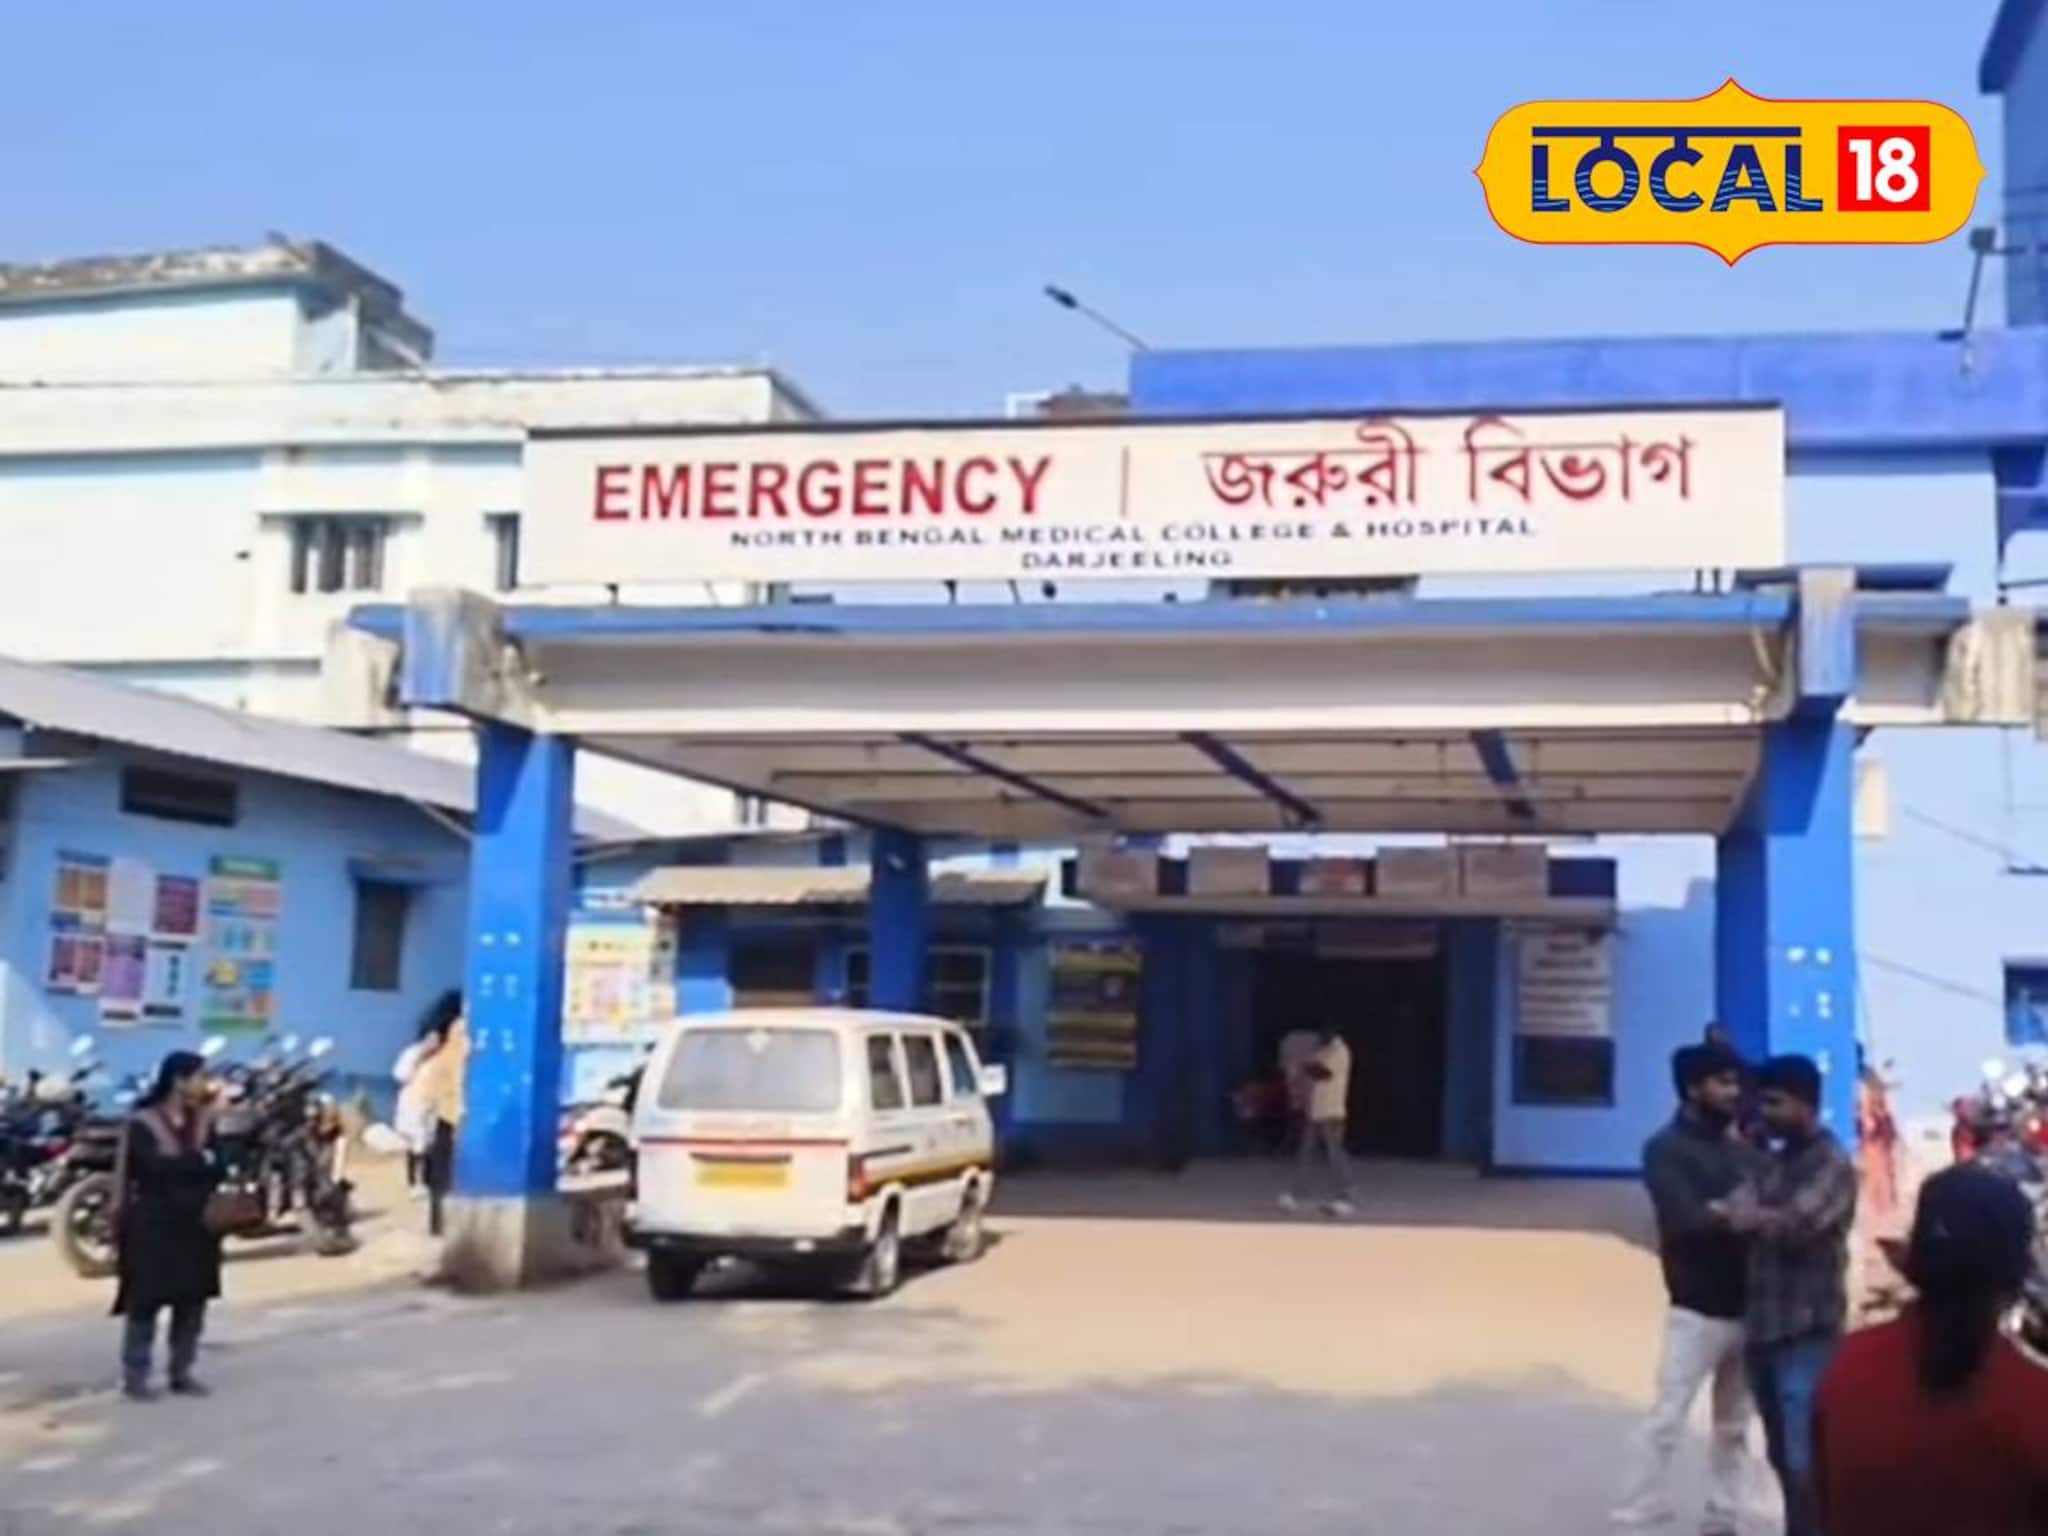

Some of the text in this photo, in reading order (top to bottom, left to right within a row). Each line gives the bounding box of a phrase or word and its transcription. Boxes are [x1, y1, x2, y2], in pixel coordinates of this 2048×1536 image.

[1202, 416, 1696, 507] জরুরী বিভাগ
[593, 456, 1052, 521] EMERGENCY
[730, 517, 1538, 547] NORTH BENGAL MEDICAL COLLEGE & HOSPITAL
[1021, 549, 1234, 568] DARJEELING
